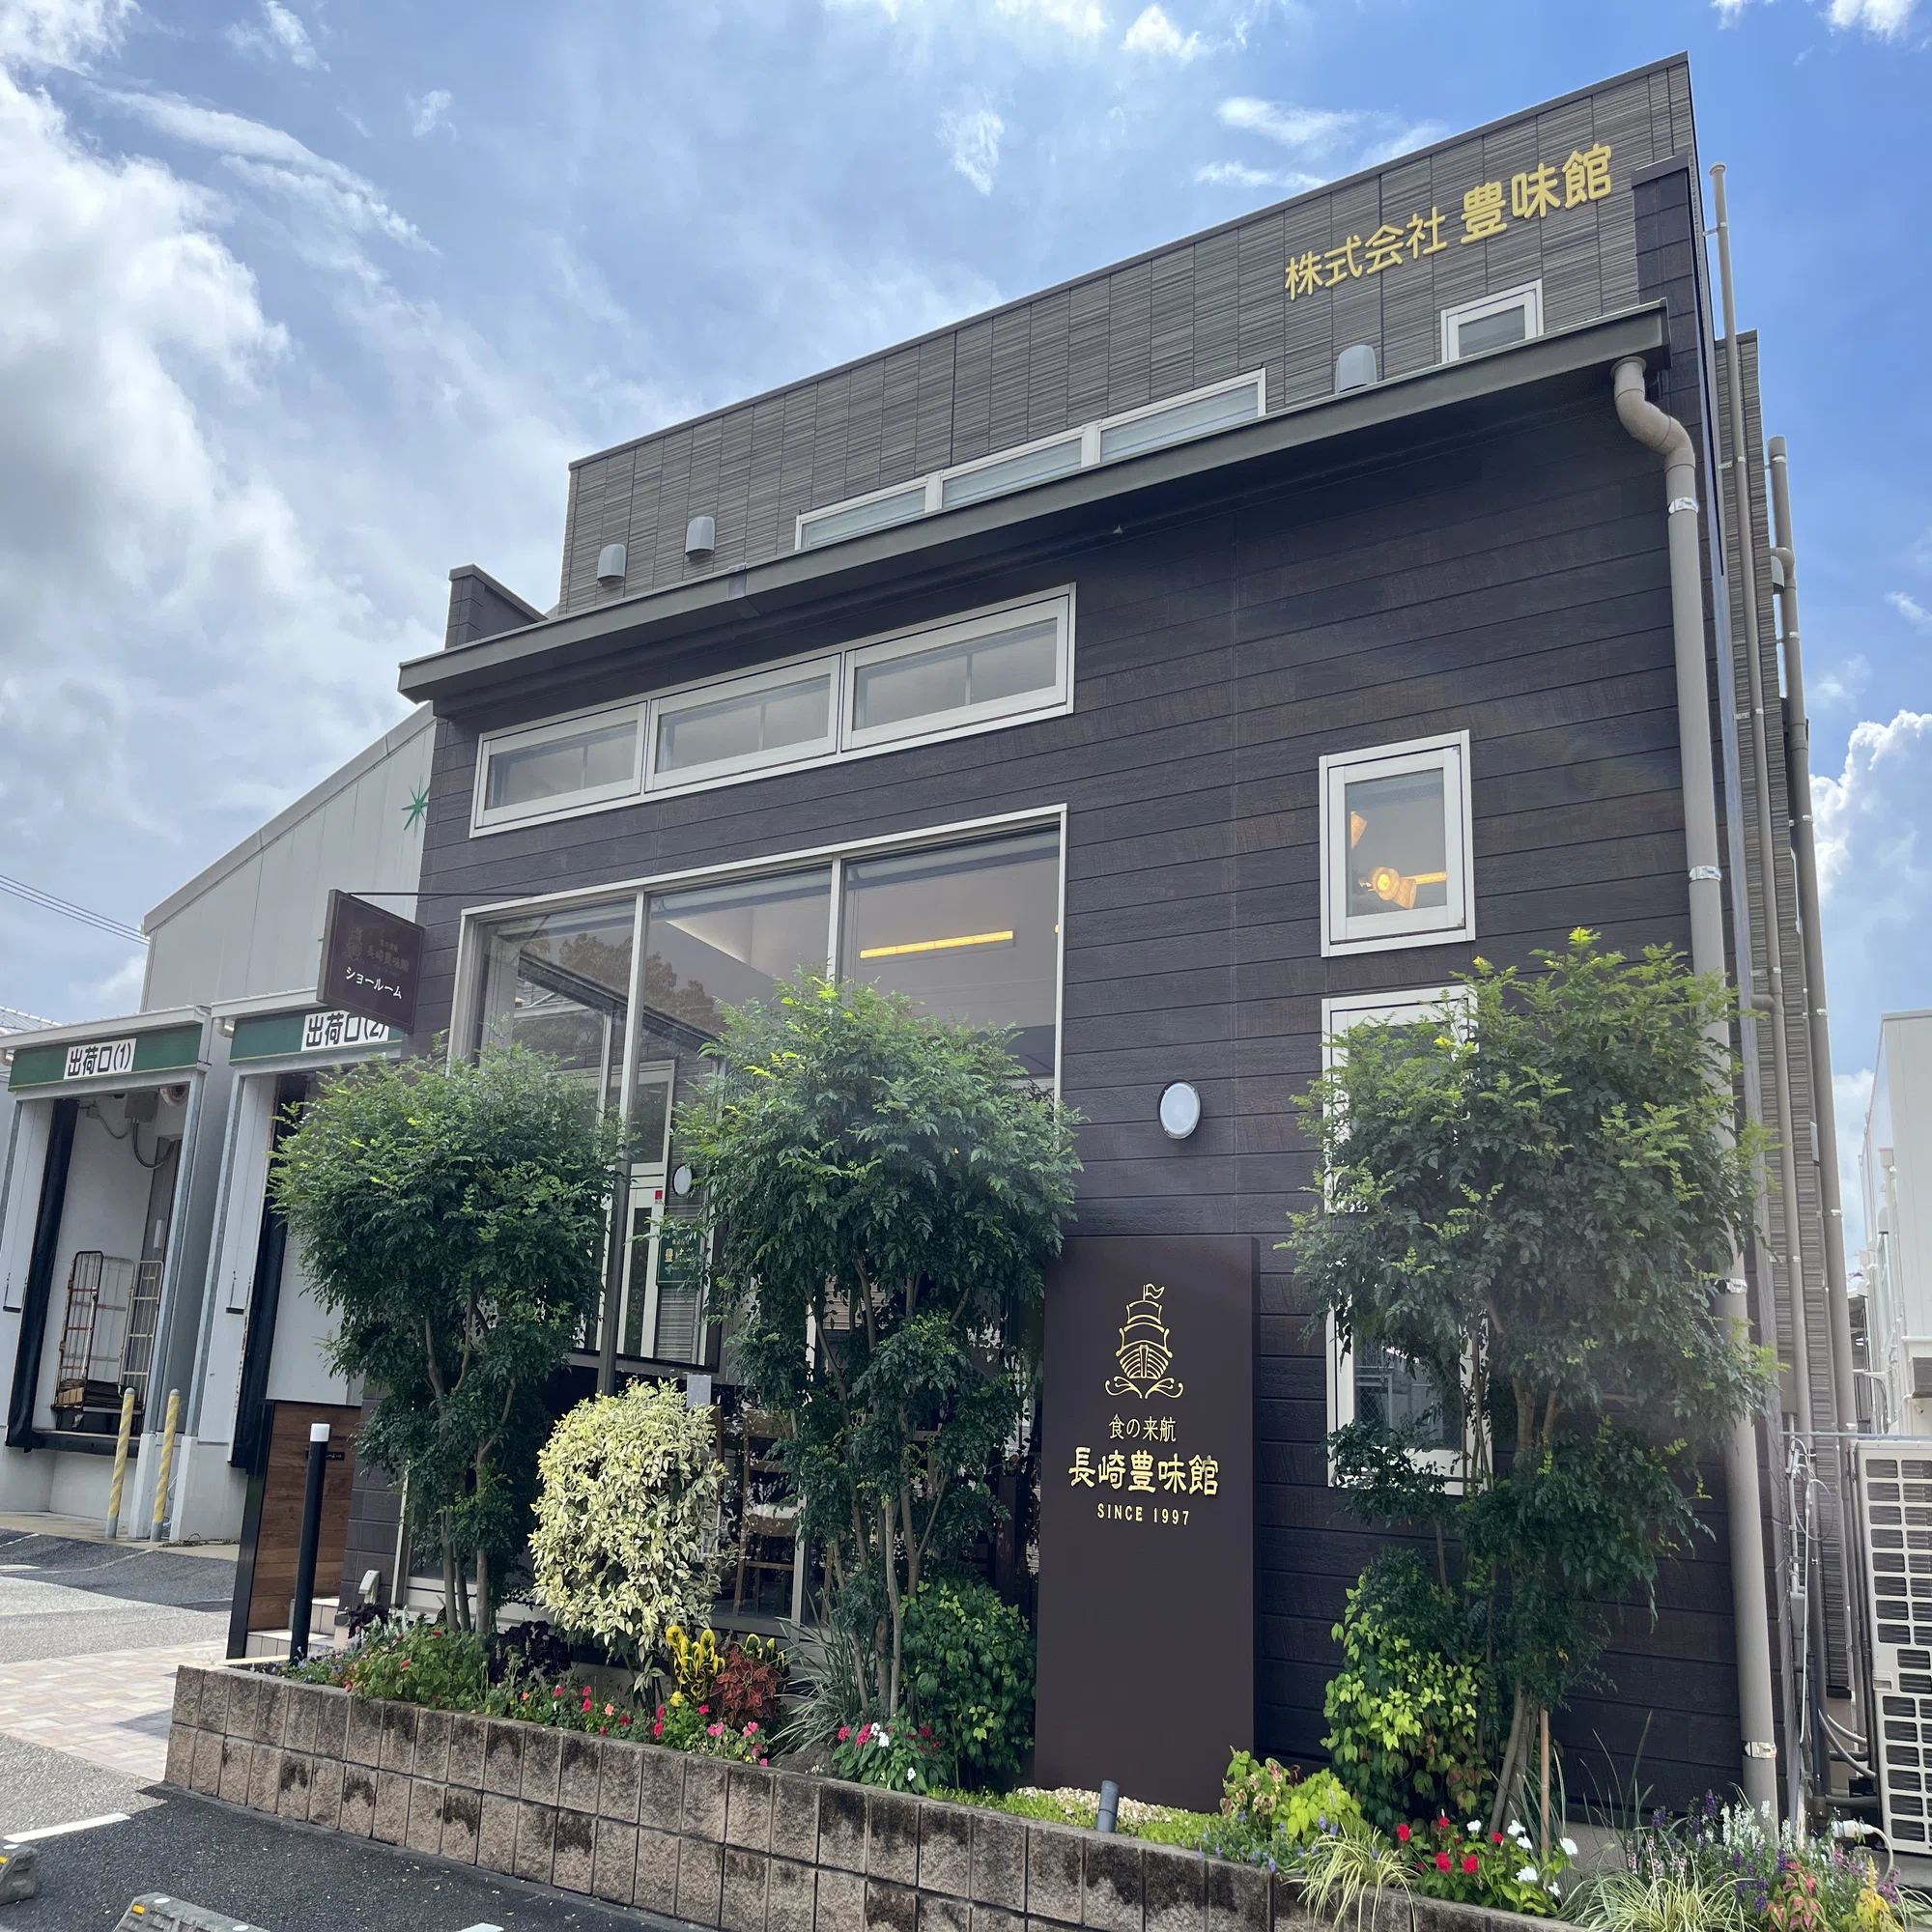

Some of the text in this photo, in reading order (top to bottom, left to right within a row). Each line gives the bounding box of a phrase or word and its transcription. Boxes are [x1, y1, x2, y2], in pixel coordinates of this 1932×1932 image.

[1285, 143, 1613, 300] 株式会社 豊味館
[345, 966, 402, 999] ショールーム
[67, 1042, 131, 1076] 出荷口(1)
[1109, 1413, 1177, 1442] 食の来航
[1068, 1447, 1219, 1496] 長崎豊味館
[1097, 1503, 1190, 1526] SINCE 1997
